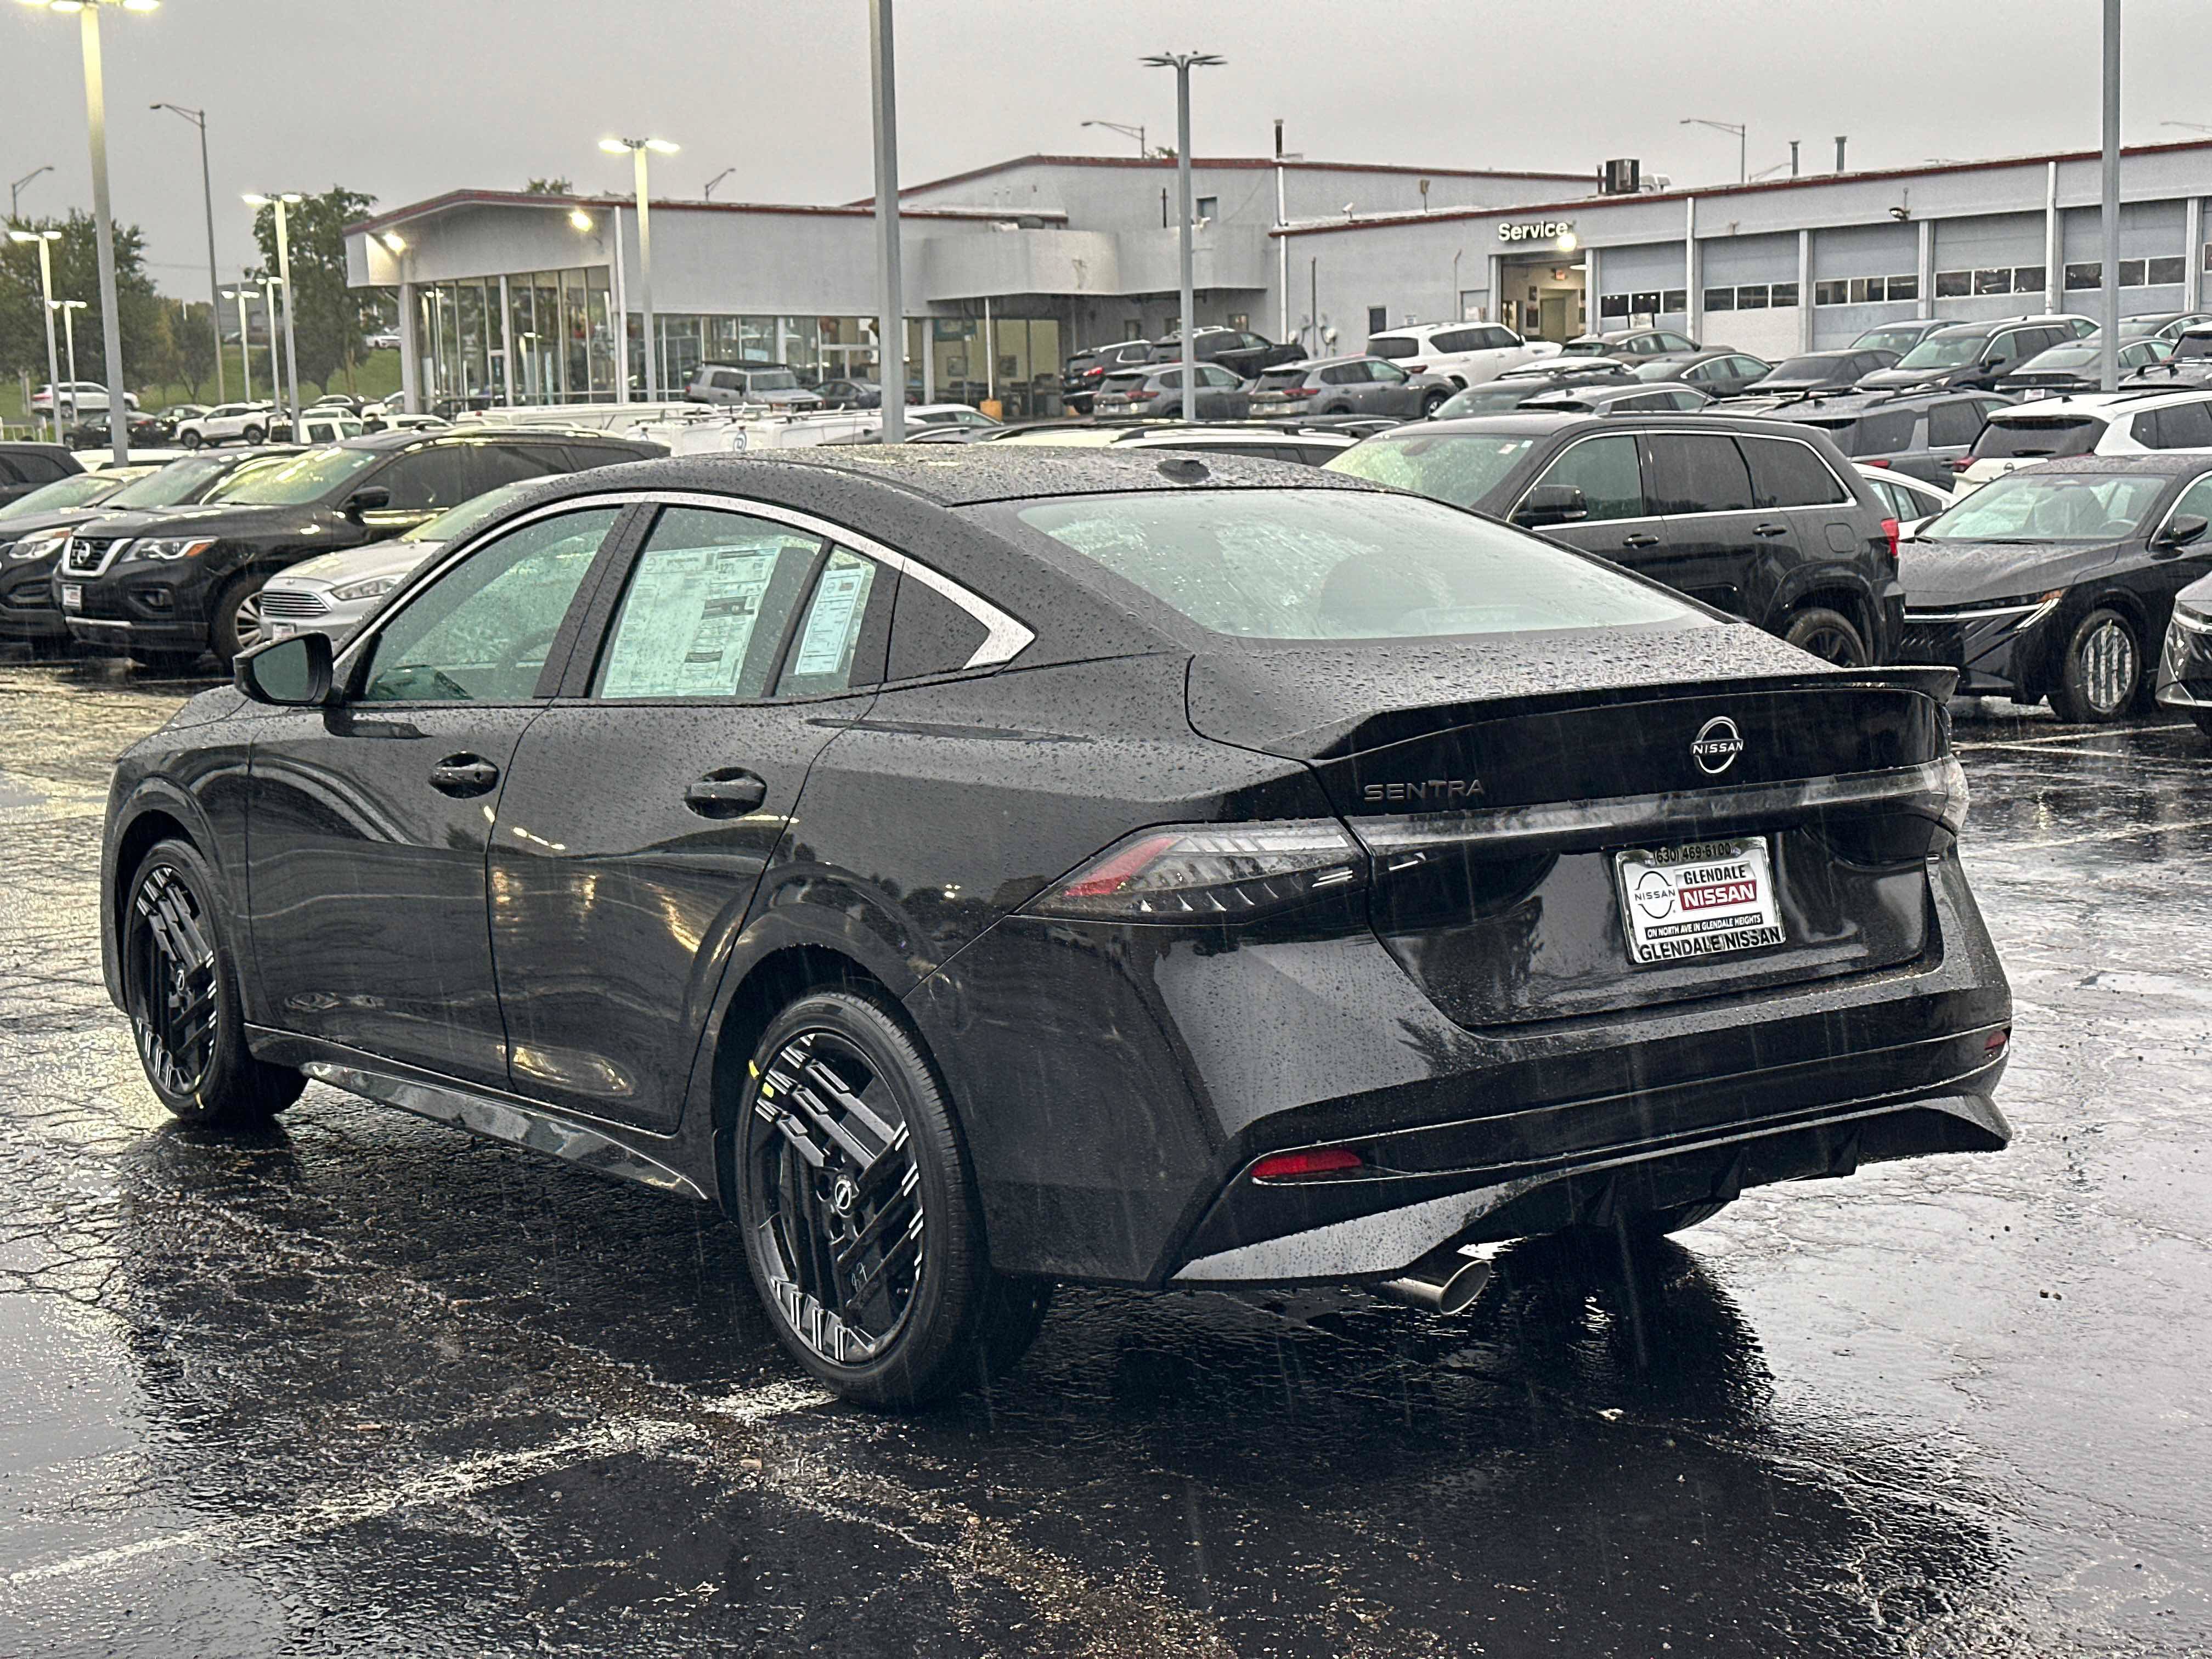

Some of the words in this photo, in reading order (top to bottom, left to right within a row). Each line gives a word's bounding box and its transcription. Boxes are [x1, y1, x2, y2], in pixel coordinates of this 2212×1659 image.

[1498, 221, 1568, 241] Service
[1693, 742, 1743, 754] NISSAN
[1364, 779, 1485, 801] SENTRA
[1654, 850, 1680, 865] (630)
[1683, 864, 1746, 885] GLENDALE
[1634, 889, 1675, 901] NISSAN
[1683, 883, 1755, 909] NISSAN
[1647, 928, 1657, 938] ON
[1658, 924, 1679, 936] NORTH
[1680, 922, 1692, 933] AVE
[1693, 921, 1700, 932] IN
[1702, 917, 1734, 930] GLENDALE
[1734, 913, 1761, 926] HEIGHTS
[1639, 934, 1722, 962] GLENDALE
[1724, 926, 1781, 950] NISSAN
